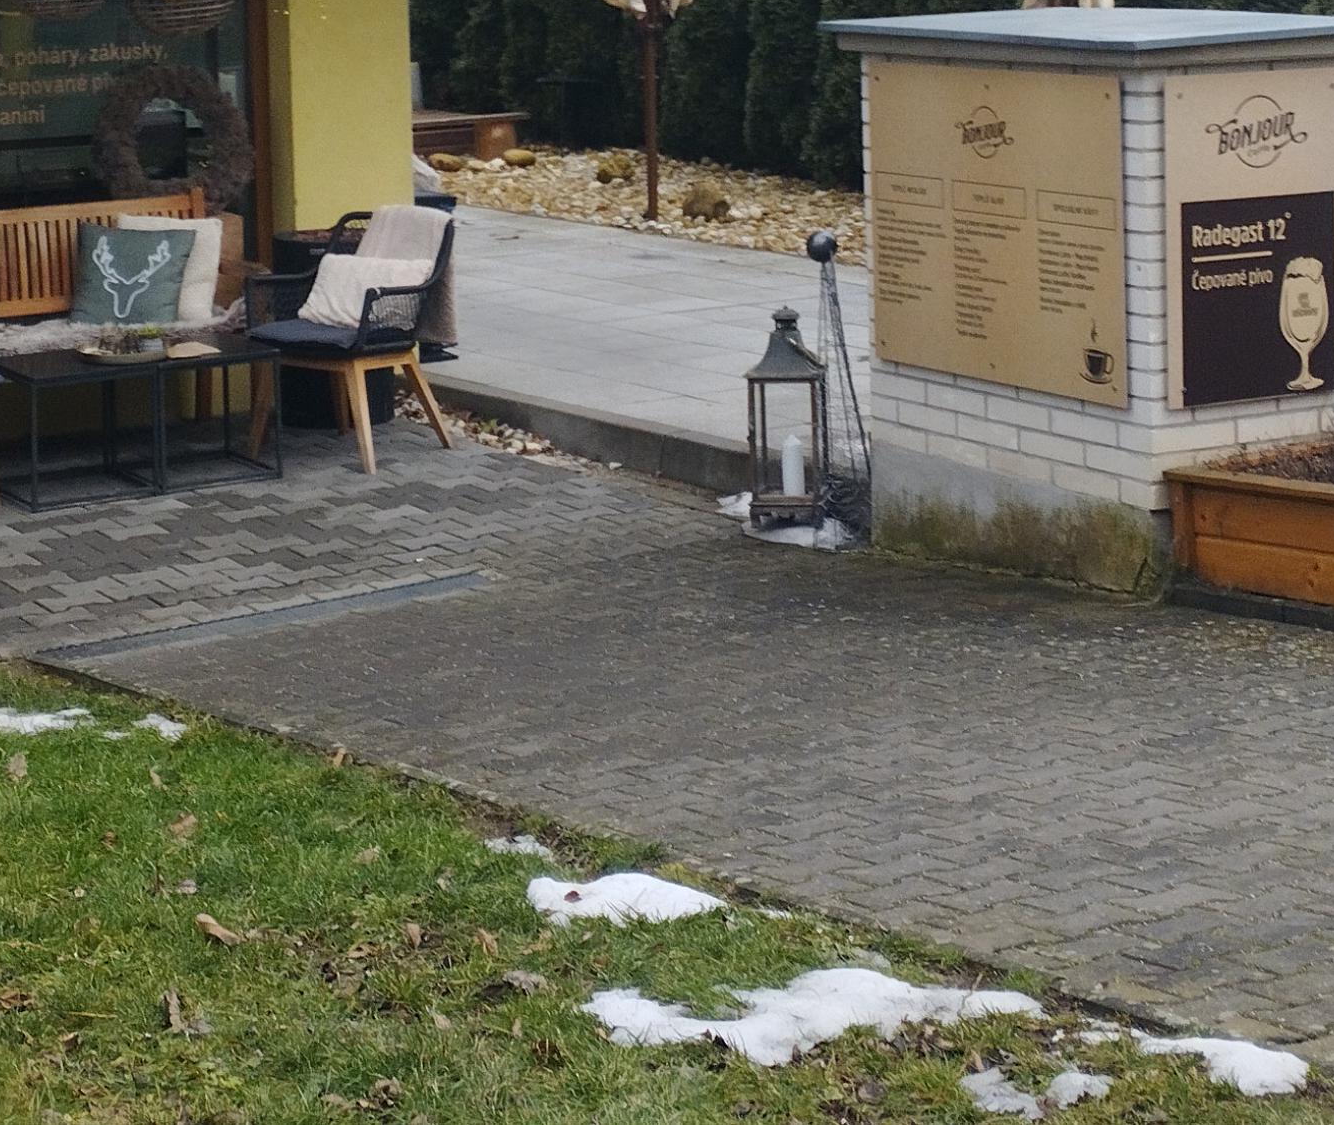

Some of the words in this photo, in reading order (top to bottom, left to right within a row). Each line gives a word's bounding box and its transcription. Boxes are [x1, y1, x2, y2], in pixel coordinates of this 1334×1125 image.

[1205, 111, 1309, 155] BONJOUR
[1191, 221, 1264, 248] Radegast
[1191, 269, 1247, 291] Čepované
[1249, 267, 1273, 287] pivo
